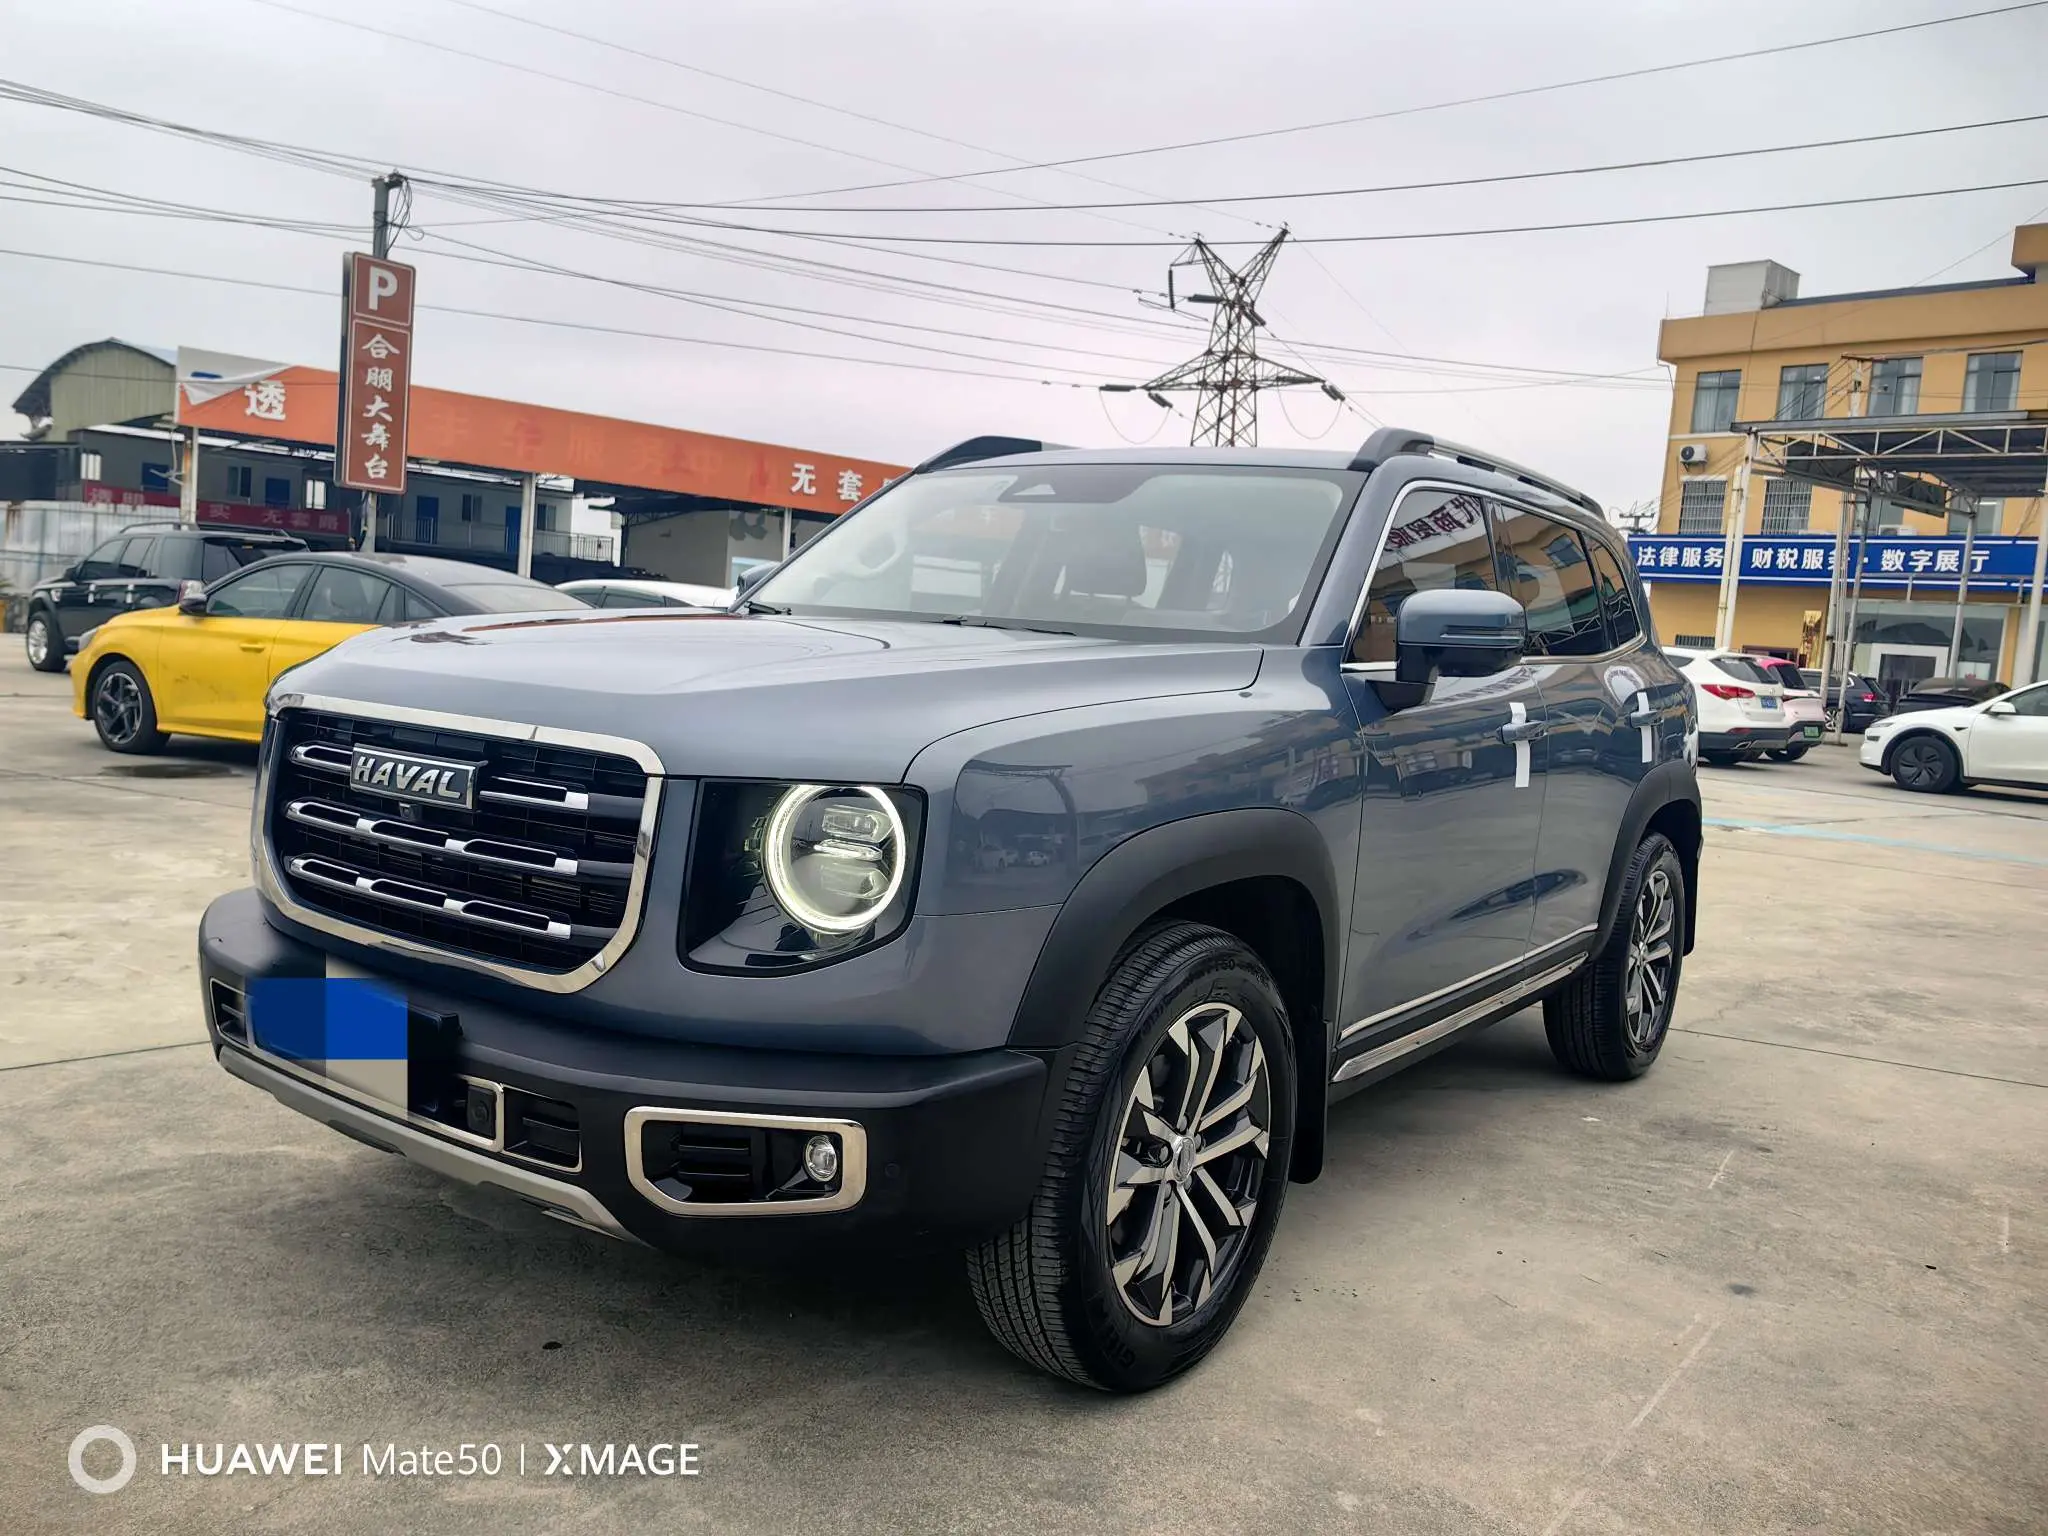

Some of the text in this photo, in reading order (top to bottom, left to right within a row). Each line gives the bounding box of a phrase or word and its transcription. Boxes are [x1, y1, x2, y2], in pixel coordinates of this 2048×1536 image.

[368, 265, 399, 311] P
[244, 380, 287, 421] 透
[791, 462, 893, 502] 无套
[1636, 546, 1725, 568] 法律服务
[1880, 548, 1990, 573] 数字展厅
[354, 756, 461, 799] HAVAL
